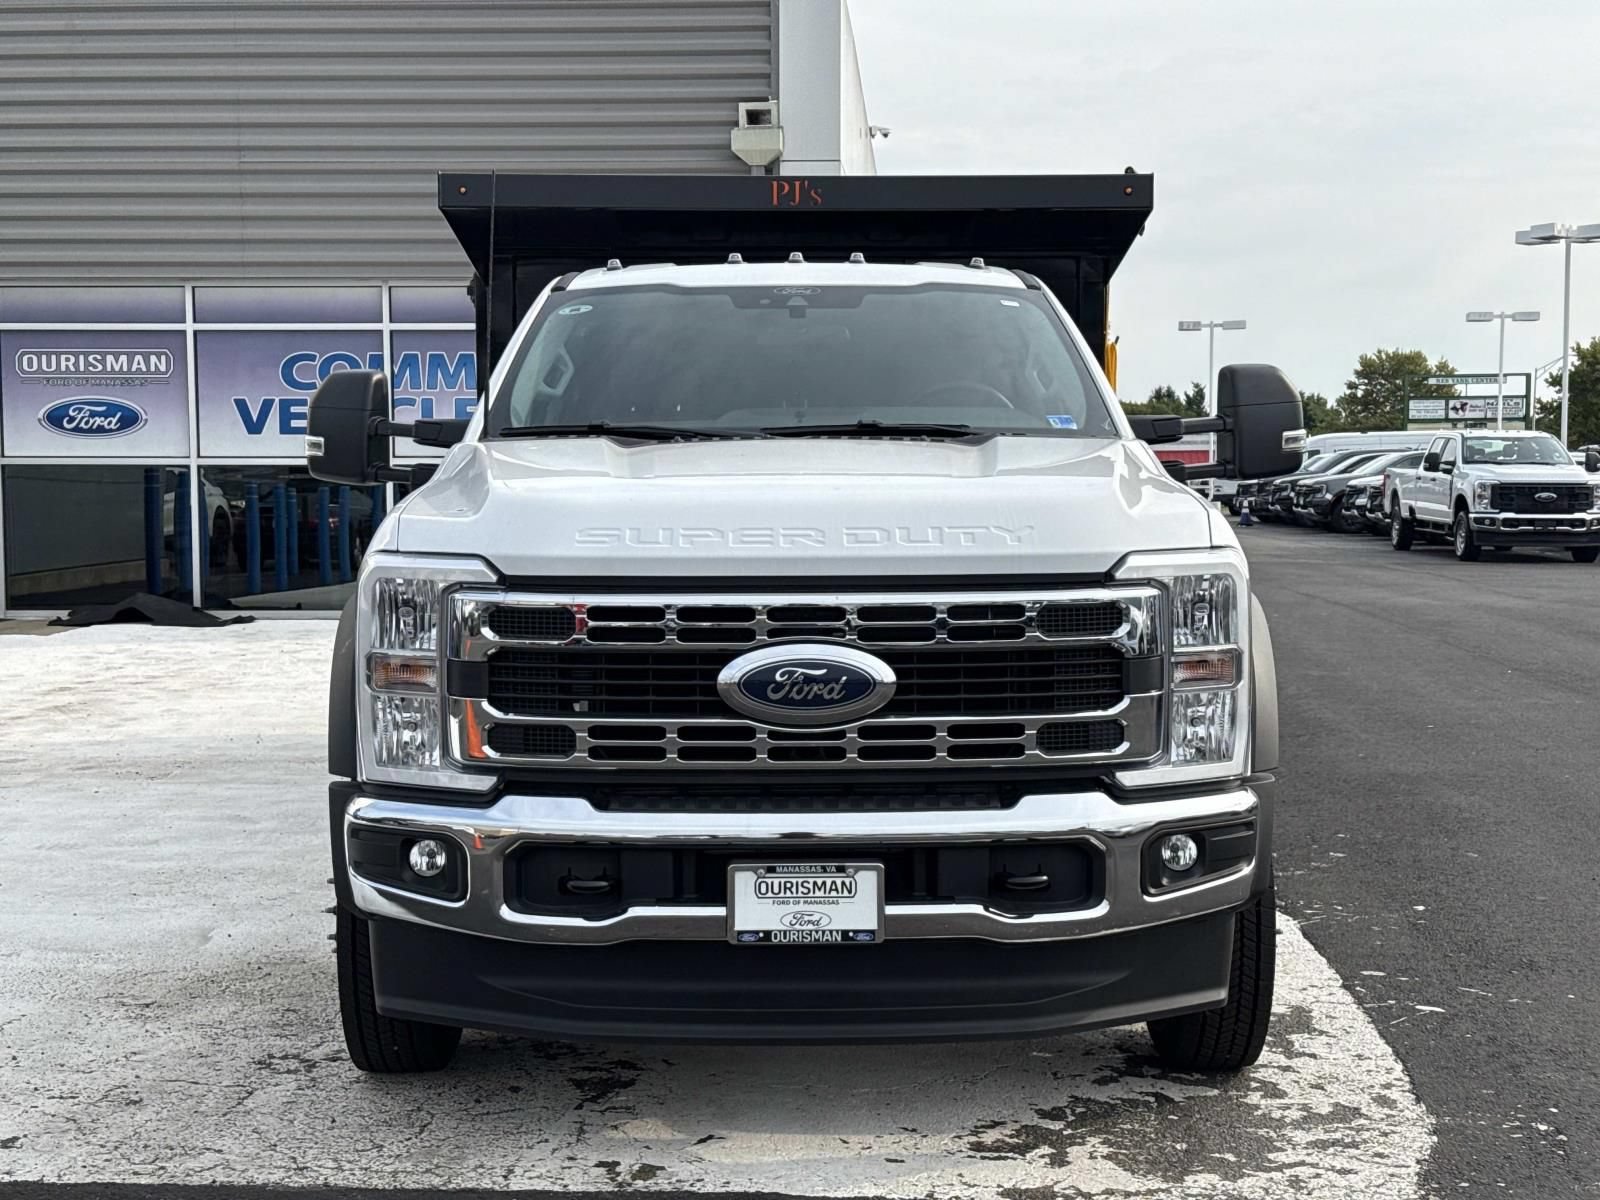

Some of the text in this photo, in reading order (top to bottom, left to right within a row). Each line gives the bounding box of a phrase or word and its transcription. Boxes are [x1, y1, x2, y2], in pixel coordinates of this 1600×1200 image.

[771, 179, 823, 206] PJ's
[22, 354, 167, 372] OURISMAN
[43, 378, 148, 387] FORD OF MANASSAS
[63, 404, 122, 430] Ford
[575, 525, 1035, 548] SUPER DUTY
[766, 667, 848, 700] Ford
[825, 865, 837, 873] VA
[757, 880, 853, 896] OURISMAN
[788, 912, 823, 928] Ford
[770, 930, 842, 942] OURISMAN
